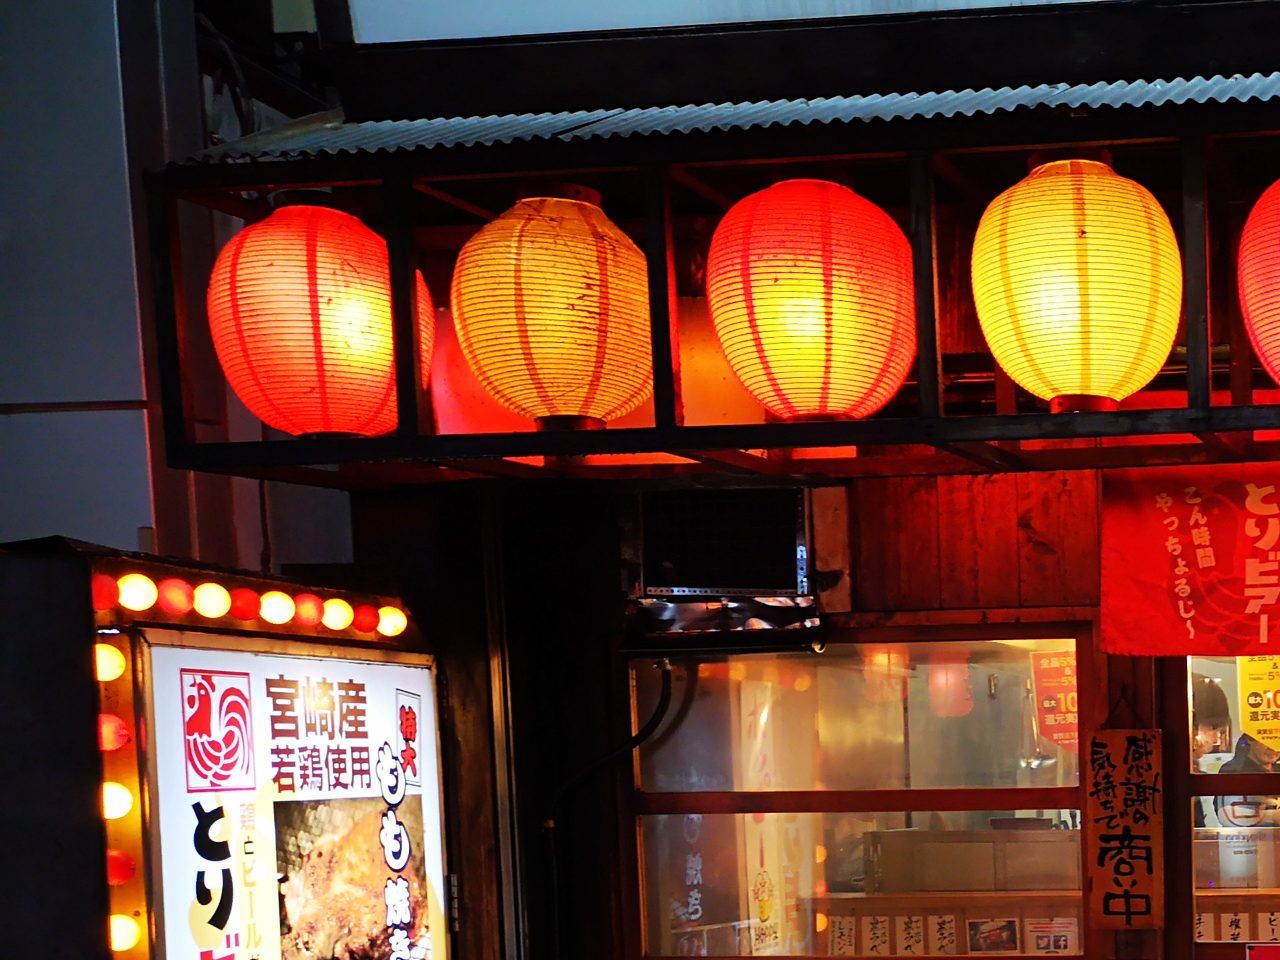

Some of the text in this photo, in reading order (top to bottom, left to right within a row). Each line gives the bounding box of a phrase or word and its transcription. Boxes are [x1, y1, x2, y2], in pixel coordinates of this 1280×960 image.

[1183, 486, 1216, 569] こん時間
[265, 674, 369, 741] 宮崎産
[270, 744, 372, 793] 若鶏使用
[1089, 737, 1125, 830] 気持ちで
[1120, 733, 1161, 826] 感謝の
[1097, 826, 1153, 925] 商い中
